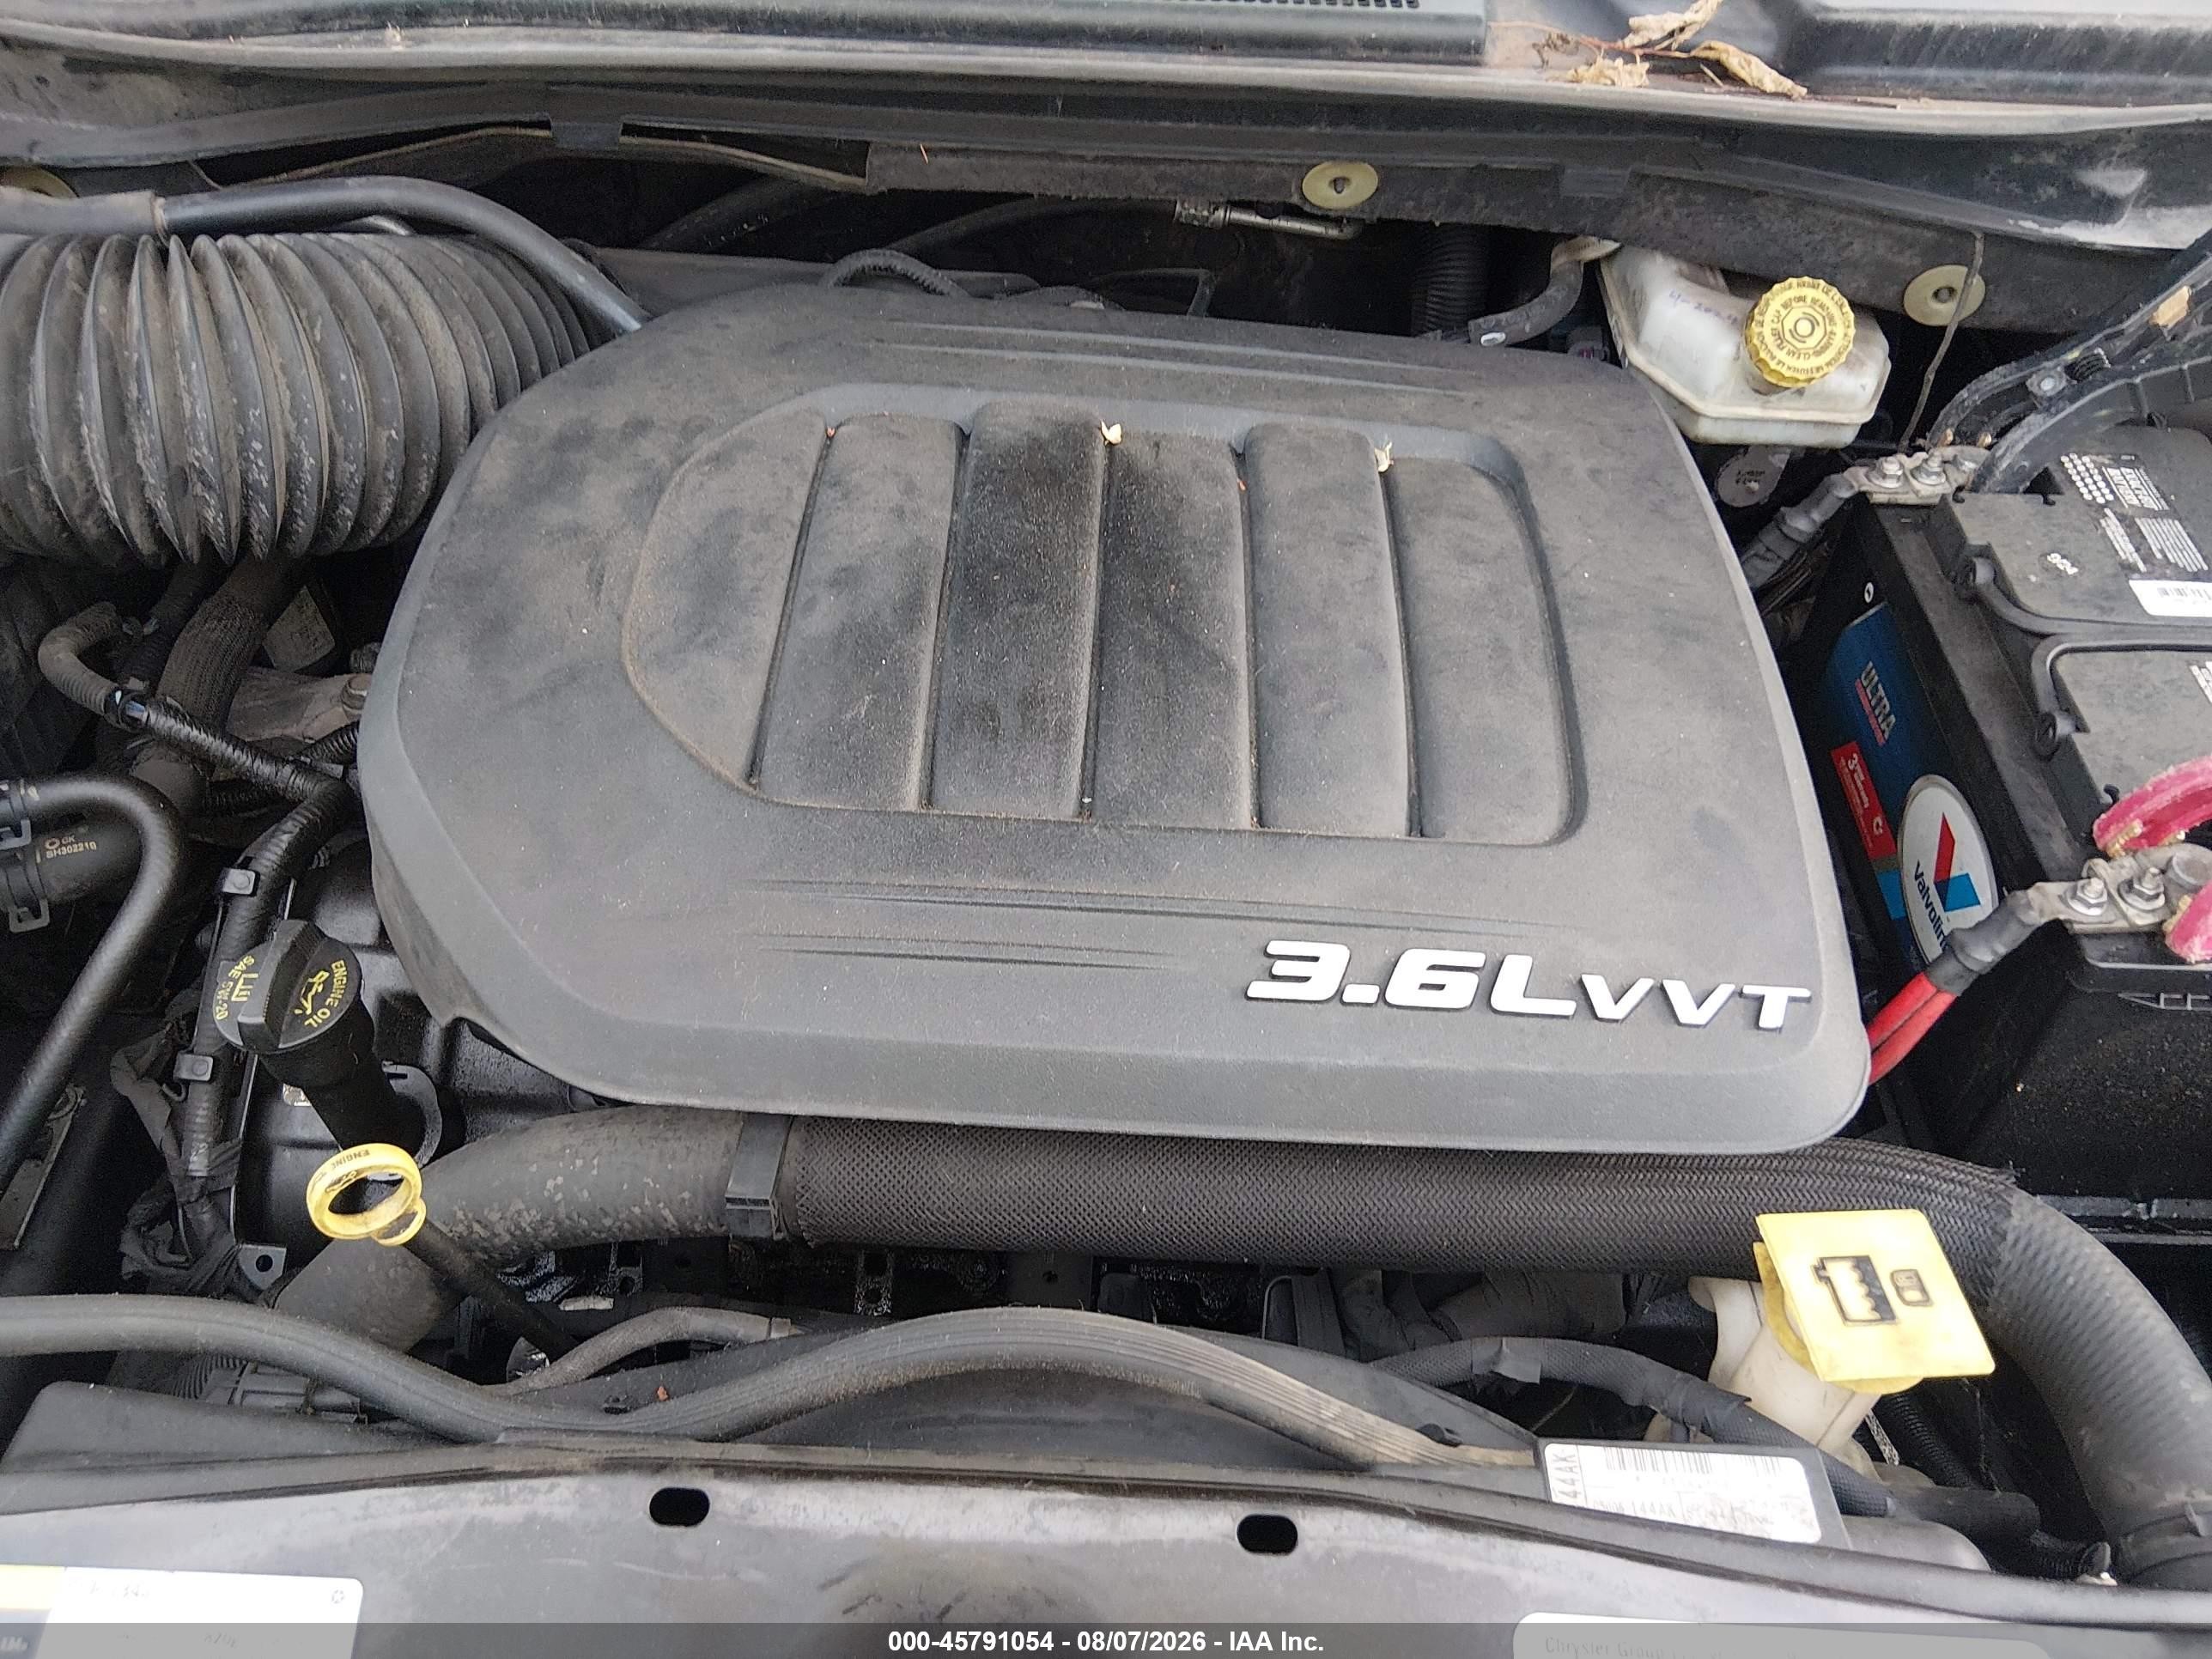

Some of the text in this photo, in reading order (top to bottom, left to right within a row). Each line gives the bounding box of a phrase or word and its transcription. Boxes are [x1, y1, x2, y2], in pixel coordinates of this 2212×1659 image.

[1860, 660, 1896, 741] ULTRA
[1913, 859, 1948, 953] Valvolin
[215, 955, 256, 1021] SAE 5W-20
[304, 959, 348, 1029] ENGINE OIL
[1246, 939, 1814, 1033] 3.6L VVT
